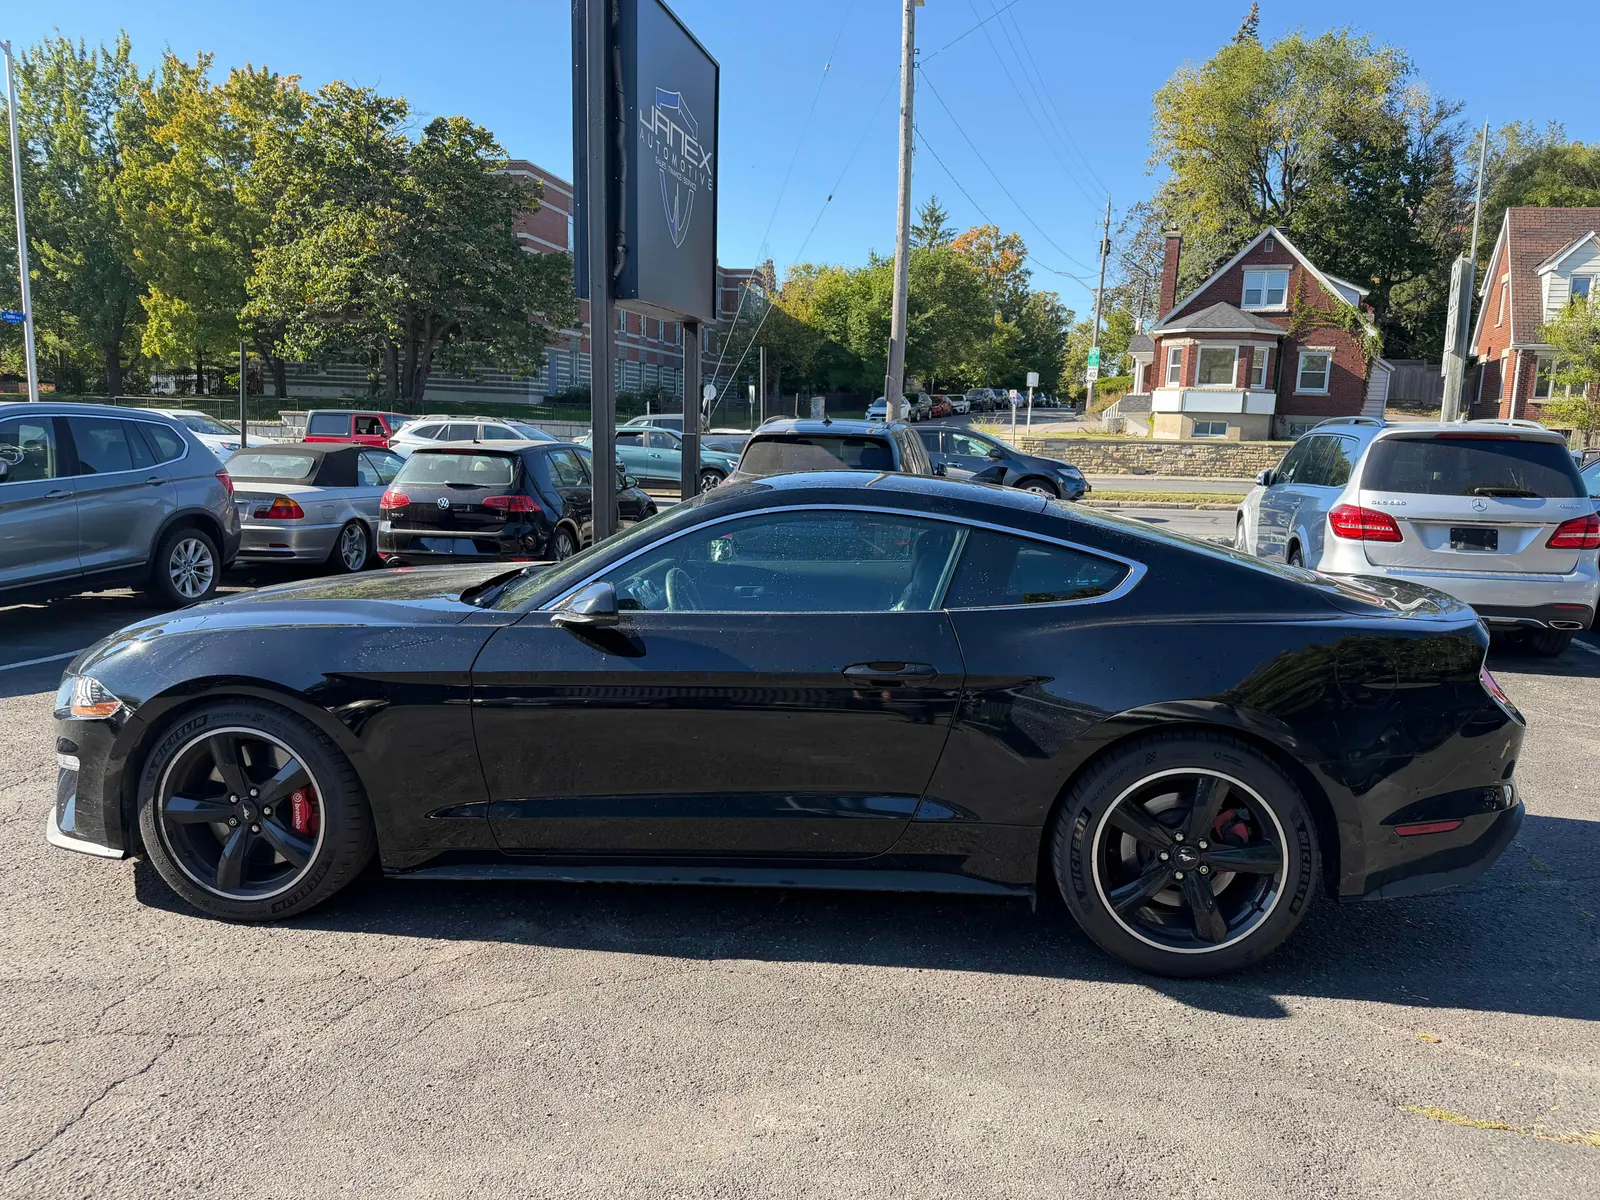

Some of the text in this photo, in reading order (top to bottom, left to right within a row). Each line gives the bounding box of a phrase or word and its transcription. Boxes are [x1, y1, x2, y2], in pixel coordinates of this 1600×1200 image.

[640, 105, 712, 176] JANEX
[640, 128, 713, 191] AUTOMOTIVE
[655, 156, 667, 170] SALES
[153, 714, 208, 768] MICHELIN
[1089, 783, 1107, 806] PILOT
[1106, 764, 1131, 786] SPORT
[1071, 811, 1091, 893] MICHELIN
[1292, 830, 1311, 912] MICHELIN
[275, 864, 329, 913] MICHELIN
